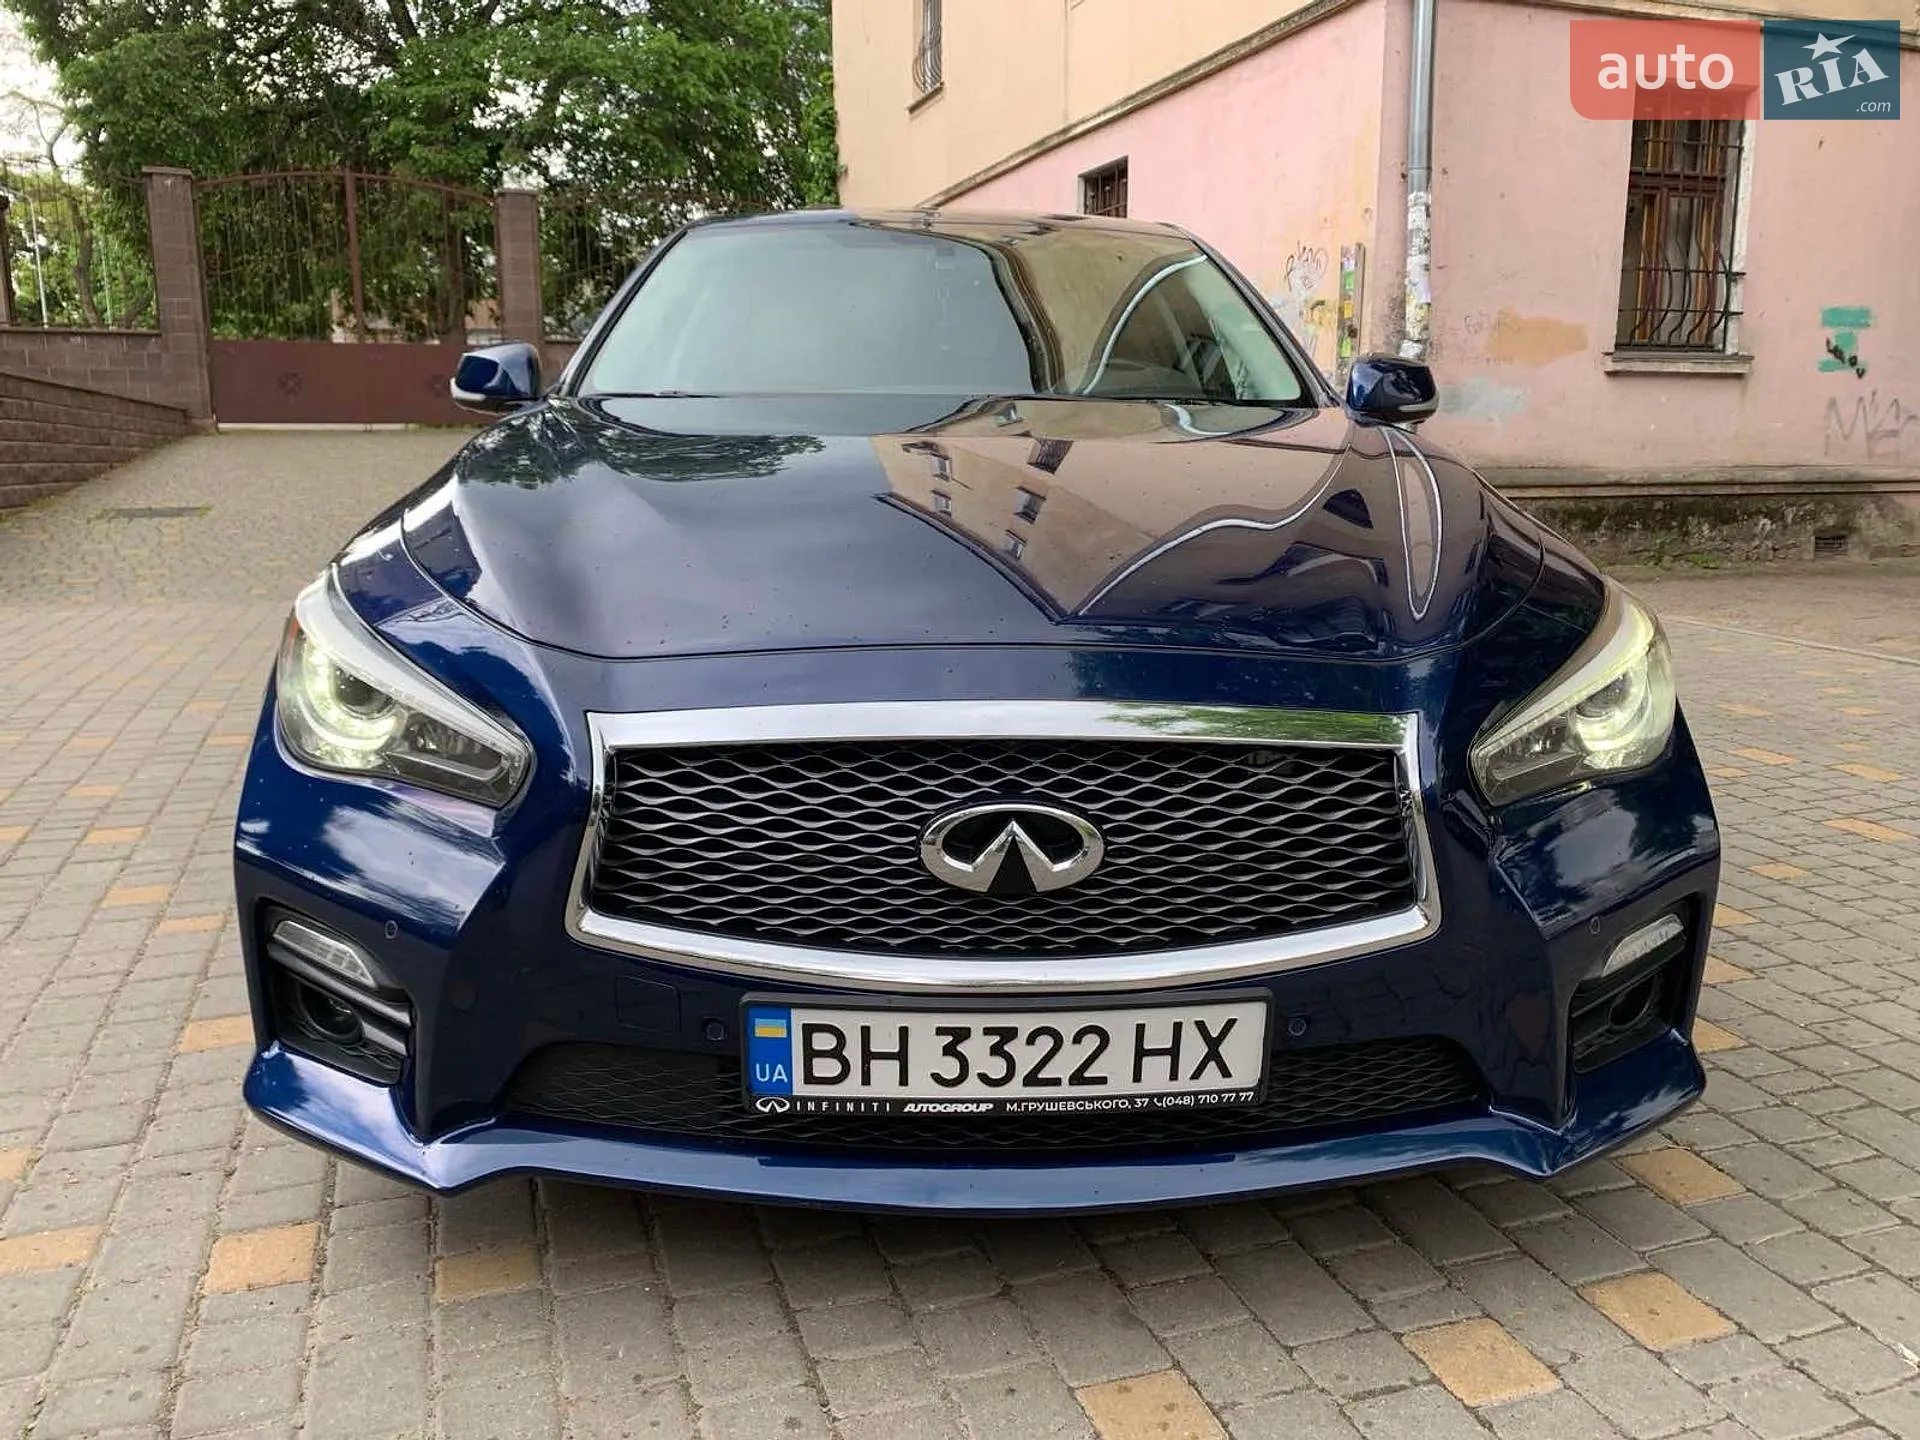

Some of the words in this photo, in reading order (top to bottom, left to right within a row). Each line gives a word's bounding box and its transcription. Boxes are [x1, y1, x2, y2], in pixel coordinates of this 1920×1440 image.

[801, 1022, 909, 1087] BH
[930, 1025, 1110, 1088] 3322
[1132, 1018, 1238, 1084] HX
[755, 1063, 788, 1083] UA
[796, 1101, 891, 1112] INFINITI
[903, 1102, 994, 1113] AUTOGROUP
[1134, 1098, 1149, 1109] 37
[1162, 1095, 1195, 1108] (048)
[1198, 1094, 1219, 1104] 710
[1221, 1093, 1237, 1103] 77
[1238, 1092, 1254, 1102] 77
